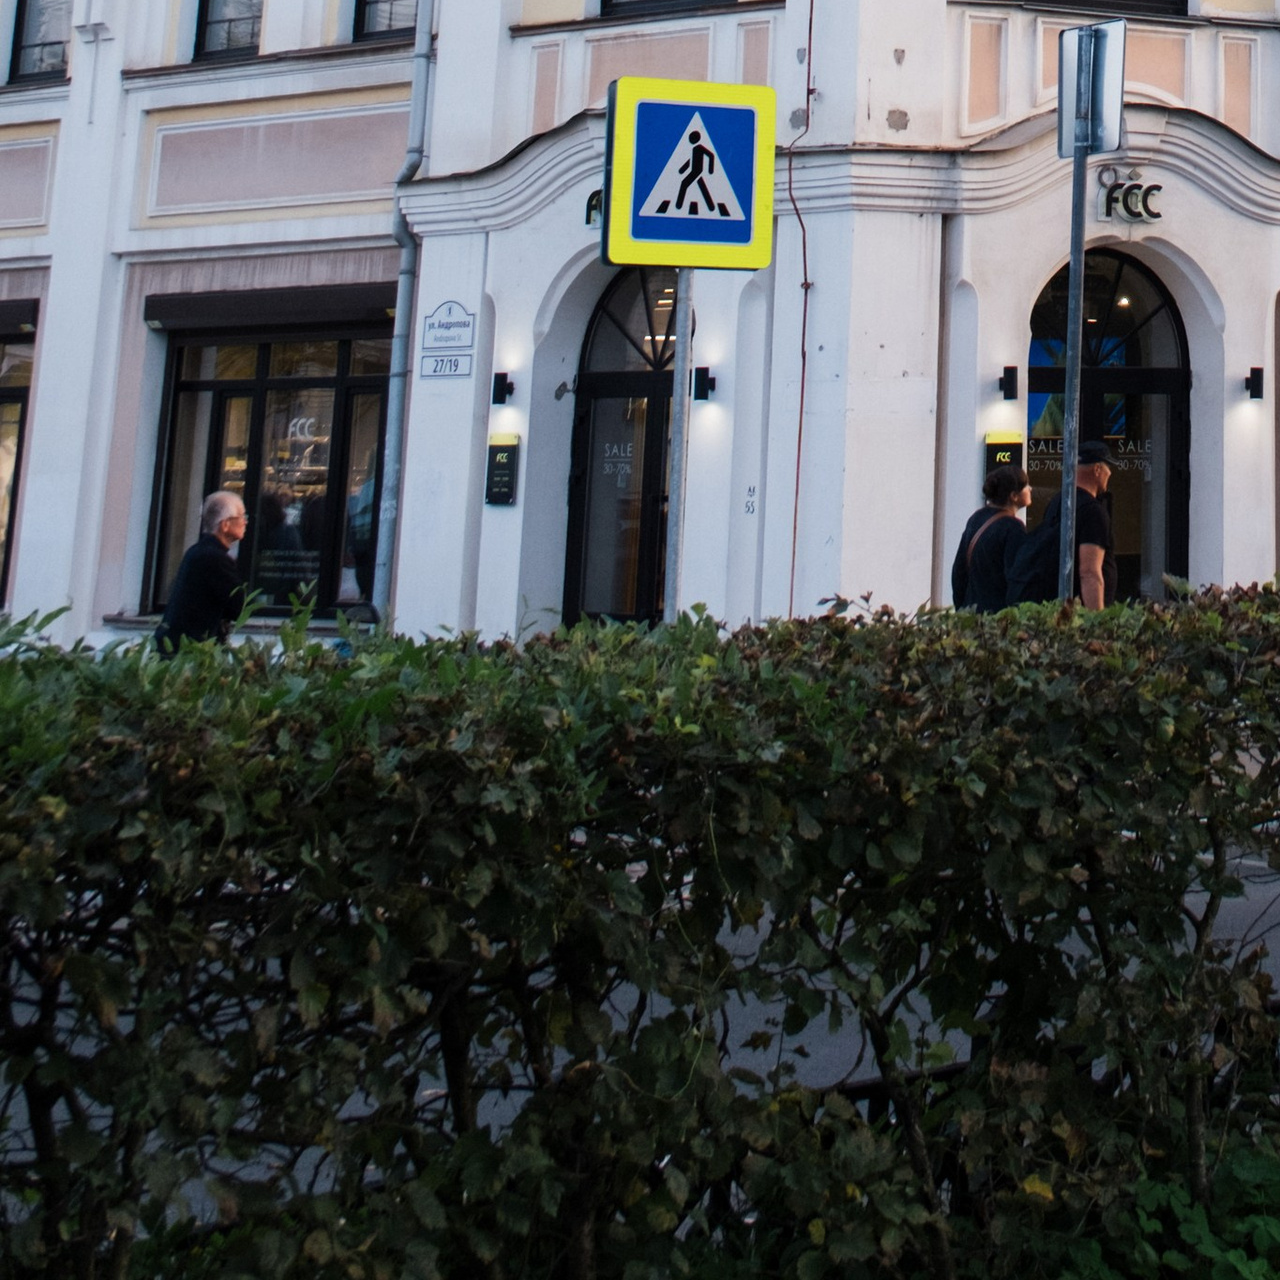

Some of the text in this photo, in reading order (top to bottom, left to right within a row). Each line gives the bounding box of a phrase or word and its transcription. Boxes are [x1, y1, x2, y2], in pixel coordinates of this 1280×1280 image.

[1105, 182, 1163, 219] FCC
[428, 320, 471, 332] ул. Андропова
[432, 358, 459, 374] 27/19
[287, 417, 316, 439] FCC
[604, 443, 633, 457] SALE
[1028, 439, 1064, 454] SALE
[1117, 439, 1152, 454] SALE
[996, 451, 1011, 463] FCC
[603, 463, 632, 475] 30-70%
[1028, 459, 1063, 472] 30-70%
[1117, 459, 1151, 471] 30-70%
